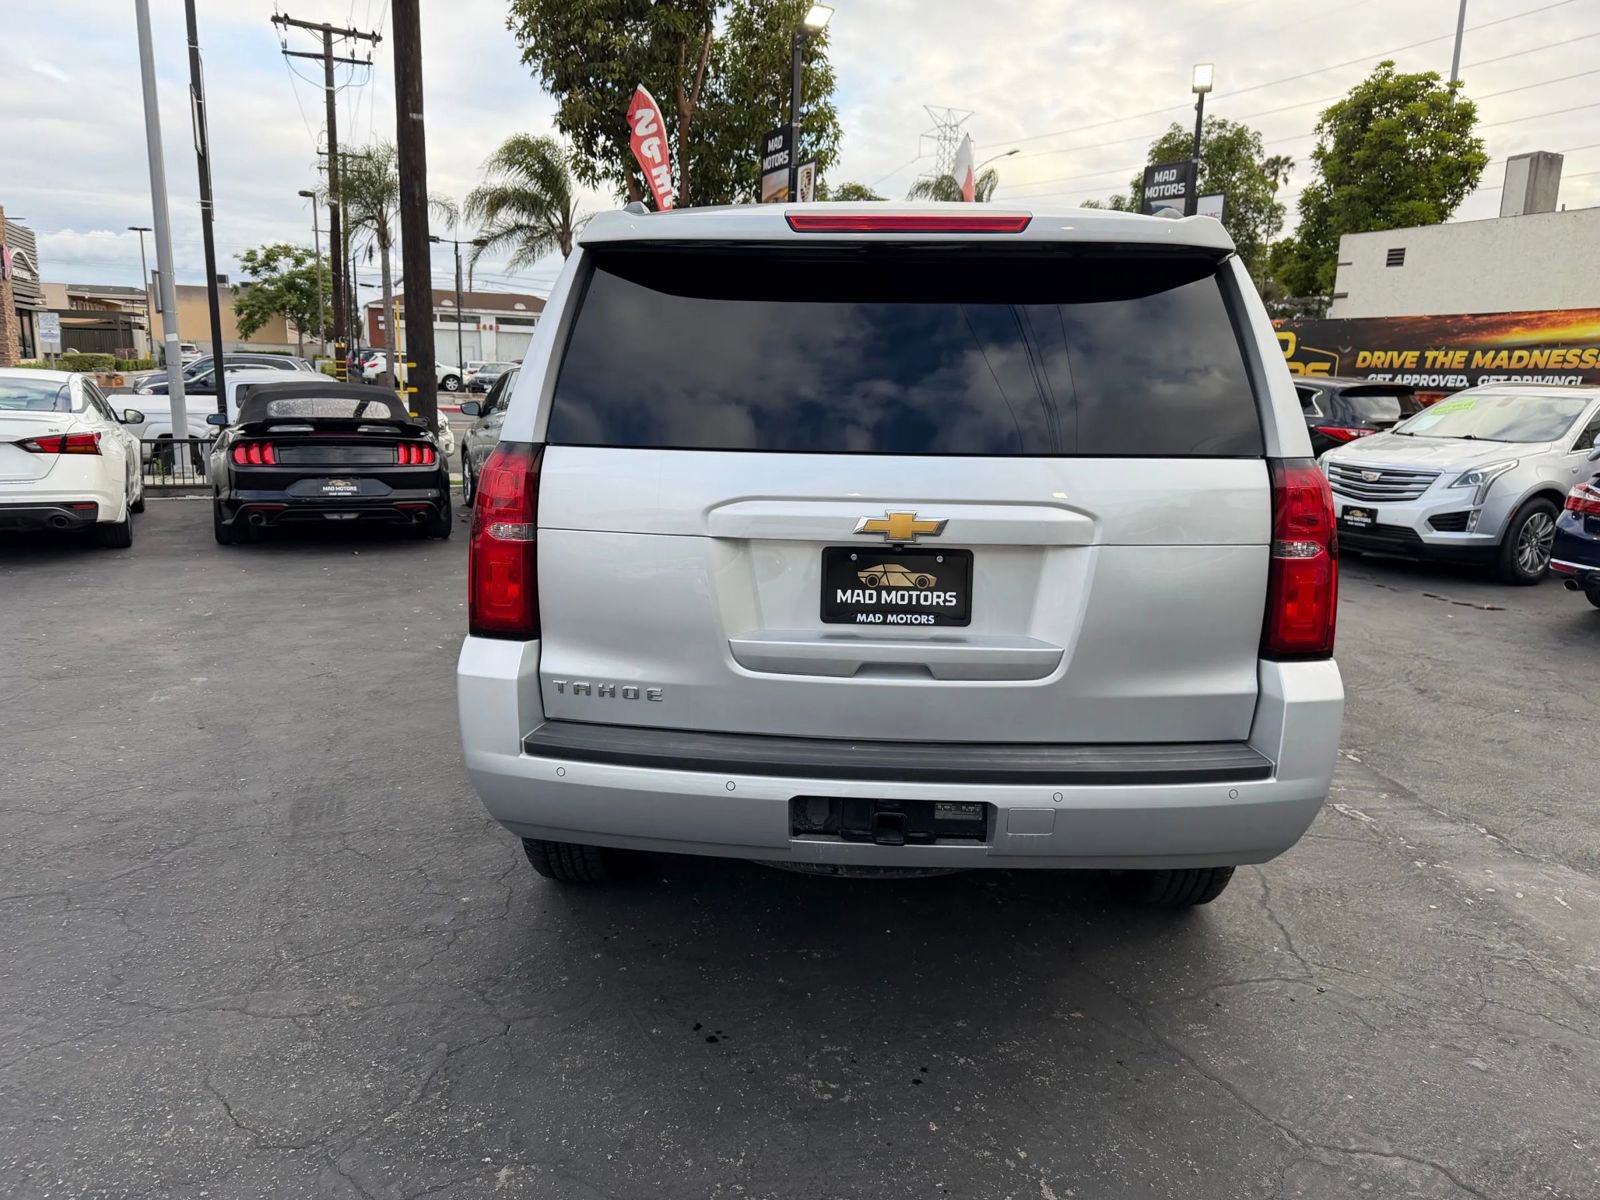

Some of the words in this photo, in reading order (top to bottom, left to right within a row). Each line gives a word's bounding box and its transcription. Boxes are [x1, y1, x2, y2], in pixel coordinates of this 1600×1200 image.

[767, 135, 783, 153] MAD
[763, 150, 789, 171] MOTORS
[1154, 169, 1177, 183] MAD
[1145, 182, 1186, 199] MOTORS
[1355, 351, 1420, 369] DRIVE
[1424, 350, 1469, 369] THE
[1367, 373, 1393, 383] GET
[1394, 374, 1470, 387] APPROVED.
[1477, 374, 1508, 386] GET
[1509, 375, 1583, 386] DRIVING!
[836, 589, 877, 604] MAD
[881, 590, 957, 606] MOTORS
[856, 613, 883, 623] MAD
[886, 614, 935, 624] MOTORS
[552, 679, 664, 702] TAHOE
